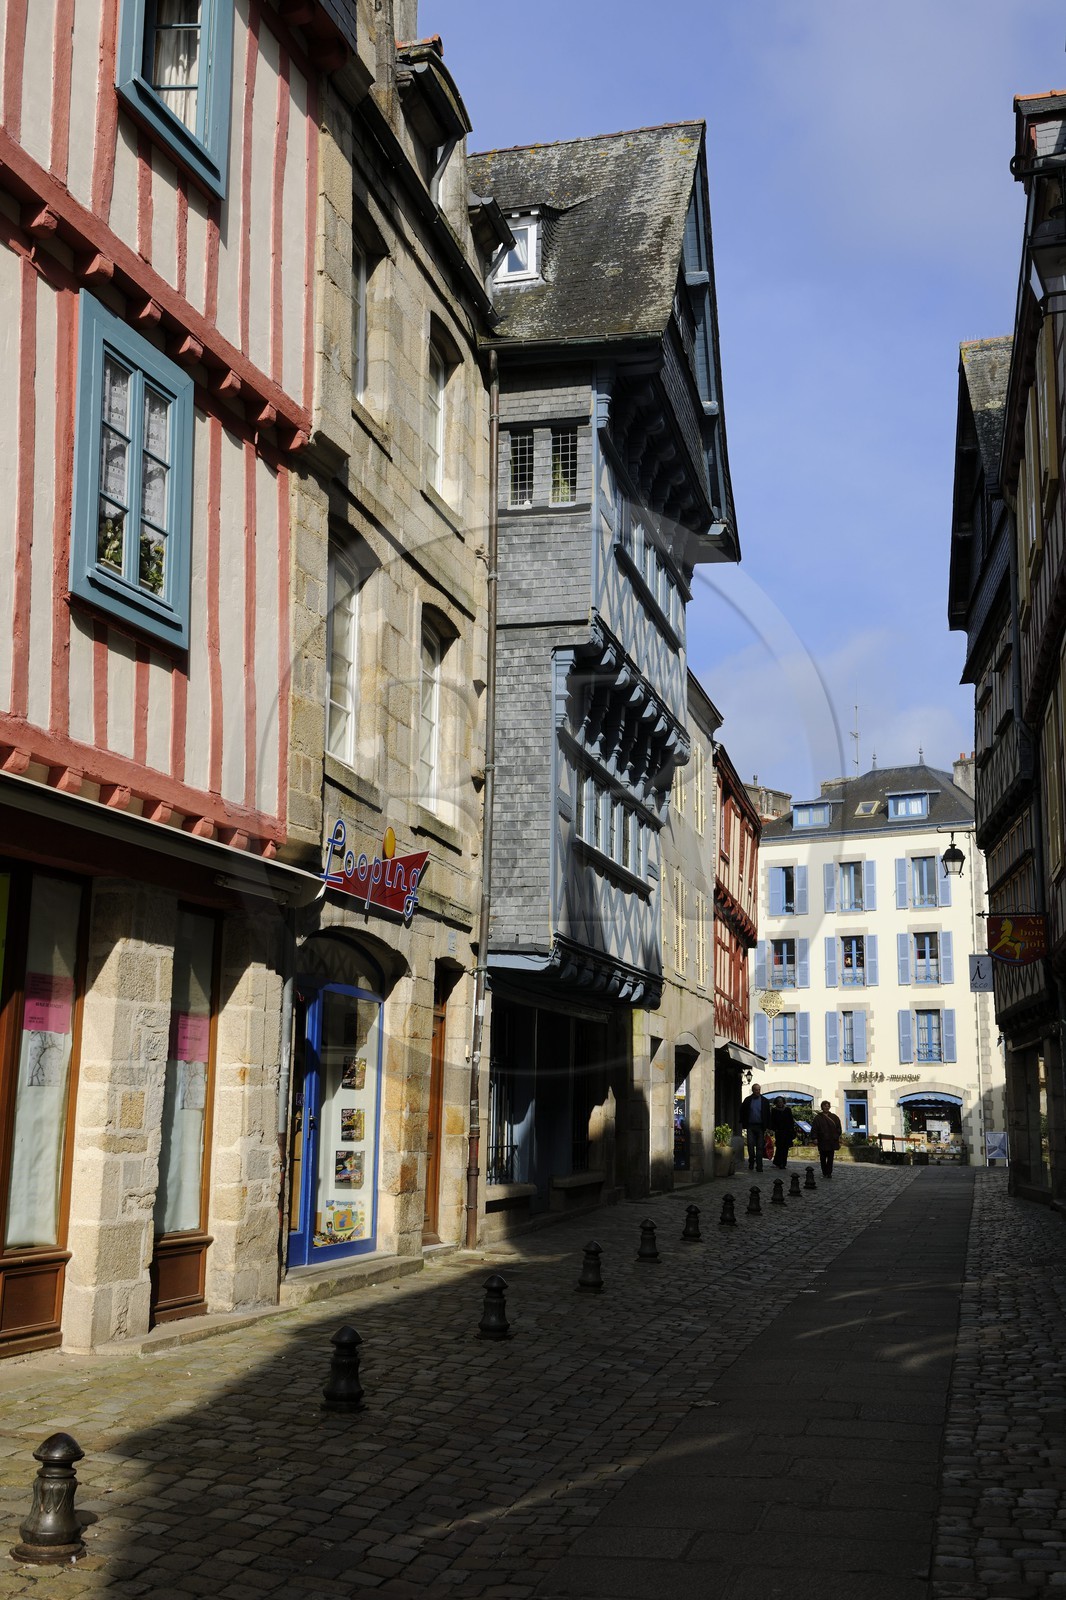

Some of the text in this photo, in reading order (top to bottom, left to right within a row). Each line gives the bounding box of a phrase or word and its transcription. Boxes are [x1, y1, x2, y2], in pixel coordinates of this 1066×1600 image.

[319, 818, 421, 921] Looping
[1026, 917, 1043, 925] Au
[1024, 940, 1045, 949] joli
